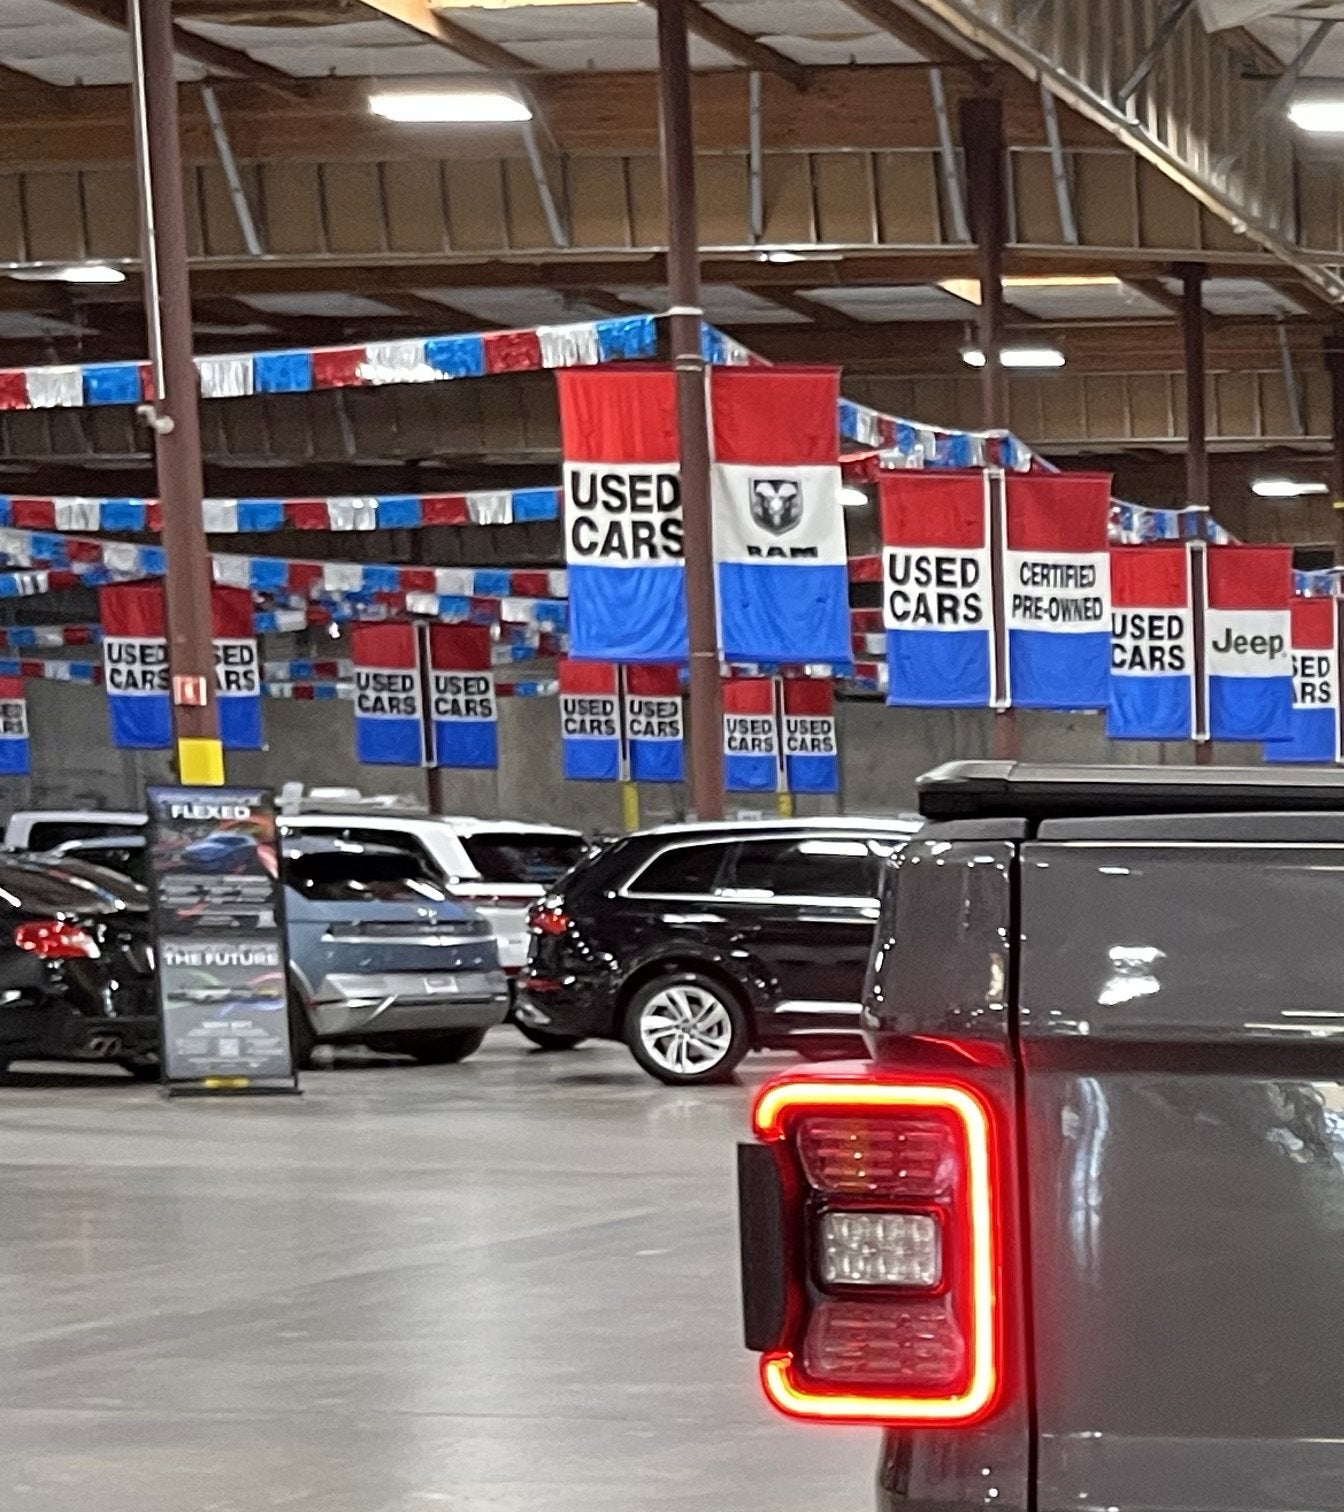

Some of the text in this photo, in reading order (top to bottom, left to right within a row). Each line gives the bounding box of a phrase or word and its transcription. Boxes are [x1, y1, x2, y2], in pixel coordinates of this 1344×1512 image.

[571, 470, 682, 514] USED
[571, 516, 684, 559] CARS
[747, 544, 818, 558] RAM
[889, 554, 980, 588] USED
[1020, 561, 1097, 588] CERTIFIED
[889, 590, 983, 625] CARS
[1012, 594, 1103, 622] PRE-OWNED
[1111, 613, 1185, 641] USED
[1212, 628, 1284, 660] Jeep
[1111, 643, 1186, 671] CARS
[110, 668, 169, 690] CARS
[356, 671, 415, 693] USED
[434, 674, 490, 696] USED
[357, 694, 417, 715] CARS
[434, 697, 492, 717] CARS
[563, 699, 614, 717] USED
[629, 700, 678, 718] USED
[563, 718, 616, 736] CARS
[629, 719, 680, 737] CARS
[726, 719, 772, 735] USED
[786, 719, 832, 735] USED
[727, 736, 774, 752] CARS
[786, 736, 834, 752] CARS
[165, 952, 279, 966] THE FUTURE
